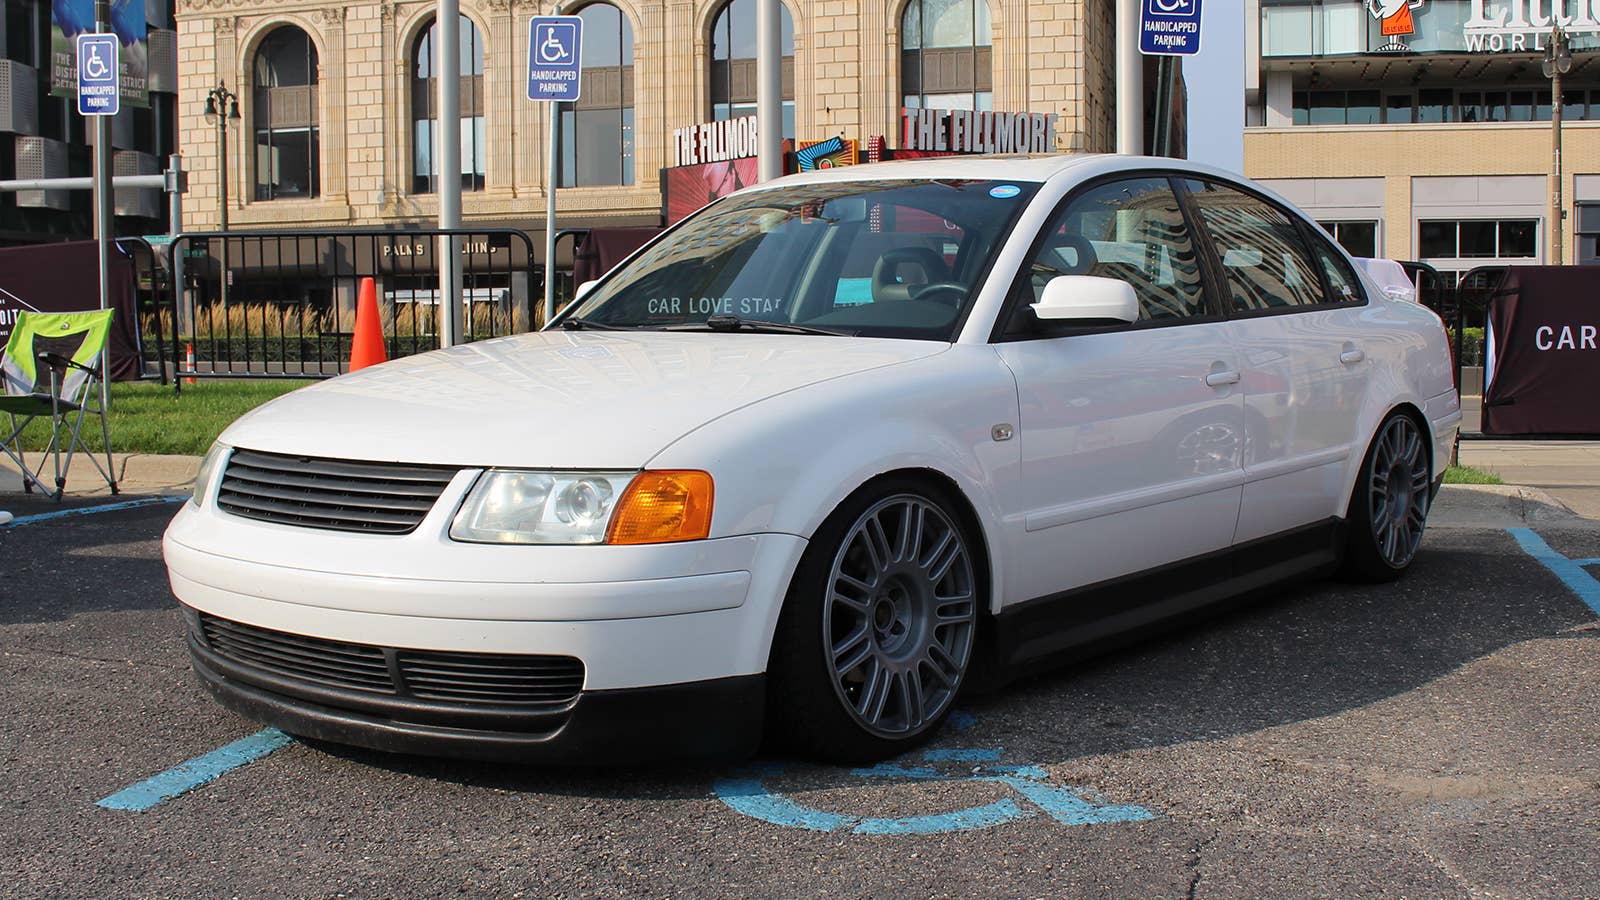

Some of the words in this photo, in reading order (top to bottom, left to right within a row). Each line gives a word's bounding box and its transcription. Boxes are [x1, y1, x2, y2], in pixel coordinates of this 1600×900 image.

[1144, 20, 1198, 33] HANDICAPPED
[1153, 35, 1187, 46] PARKING
[1464, 32, 1569, 52] WORL
[56, 53, 71, 66] THE
[531, 70, 577, 81] HANDICAPPED
[81, 86, 115, 96] HANDICAPPED
[539, 83, 568, 93] PARKING
[87, 97, 109, 107] PARKING
[902, 107, 947, 151] THE
[951, 110, 1059, 154] FILLMORE
[673, 125, 698, 167] THE
[700, 115, 758, 164] FILLMOR
[648, 298, 681, 314] CAR
[689, 297, 733, 314] LOVE
[1535, 325, 1597, 351] CAR
